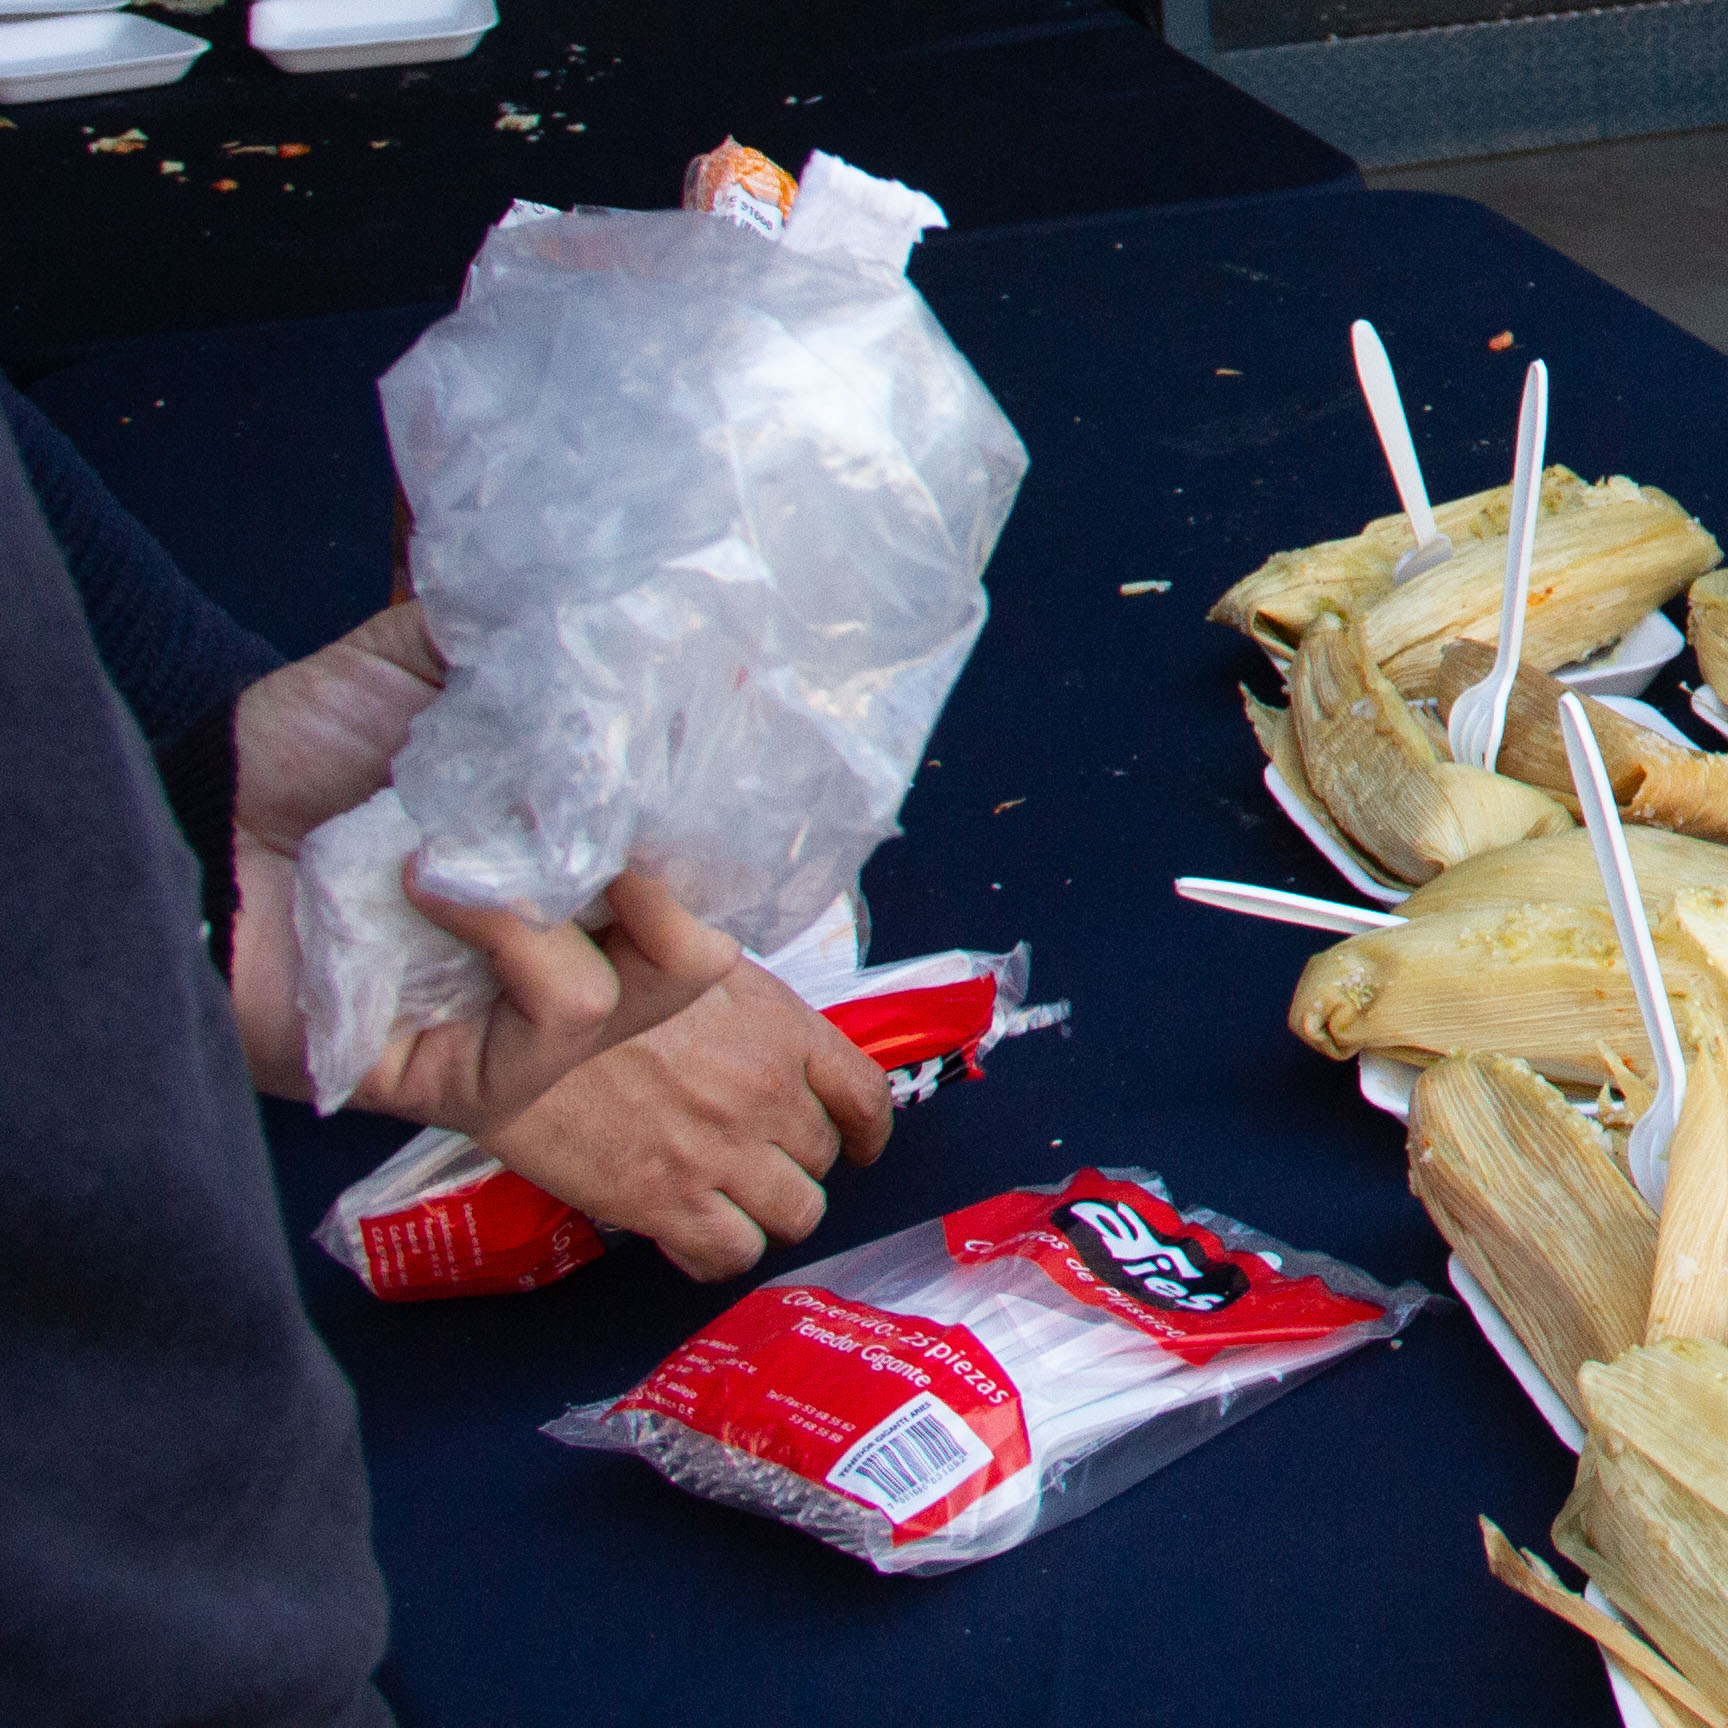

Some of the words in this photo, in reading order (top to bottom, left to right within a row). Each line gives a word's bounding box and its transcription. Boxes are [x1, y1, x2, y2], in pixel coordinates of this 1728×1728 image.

[1066, 1258, 1095, 1282] de
[1070, 1201, 1225, 1310] Aries
[791, 1316, 863, 1353] Tenedor
[860, 1344, 932, 1388] Gigante
[899, 1331, 935, 1348] 25
[924, 1342, 1008, 1404] piezas
[838, 1441, 875, 1478] TENEDOR
[874, 1416, 911, 1444] GIGANTE
[909, 1401, 933, 1419] ARIES
